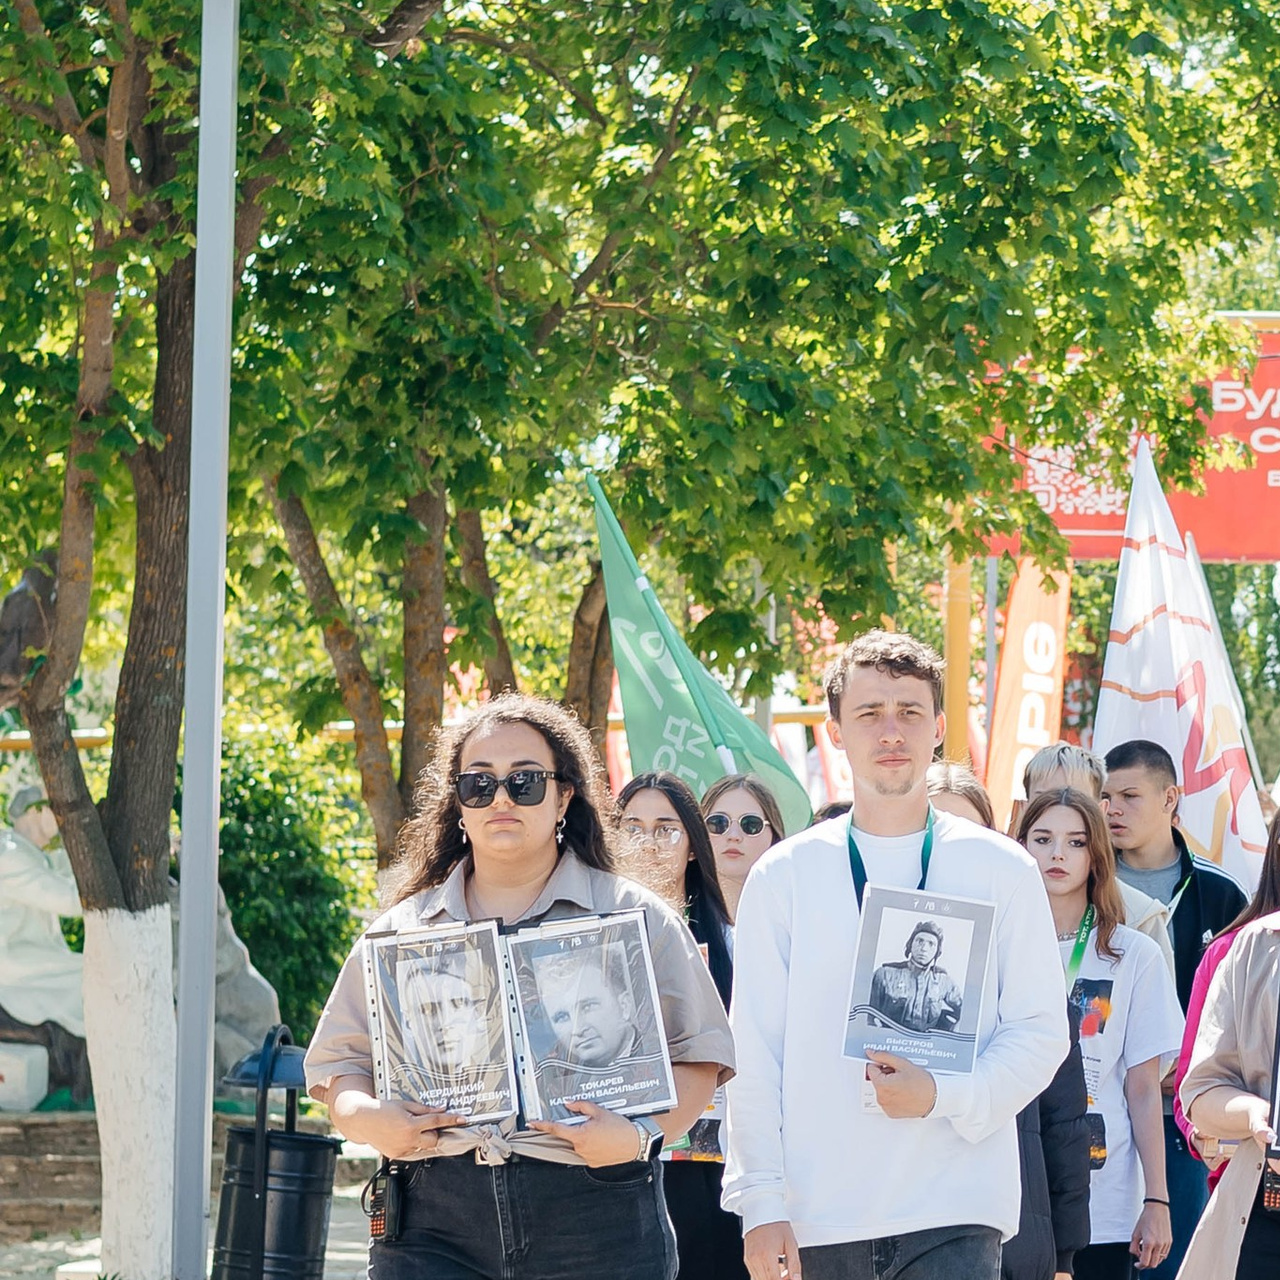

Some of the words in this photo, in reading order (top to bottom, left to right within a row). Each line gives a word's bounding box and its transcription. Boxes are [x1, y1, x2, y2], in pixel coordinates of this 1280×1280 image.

[419, 1080, 485, 1100] ЖЕРДИЦКИЙ
[579, 1076, 625, 1092] ТОКАРЕВ
[595, 1078, 660, 1098] ВАСИЛЬЕВИЧ
[448, 1089, 511, 1108] АНДРЕЕВИЧ
